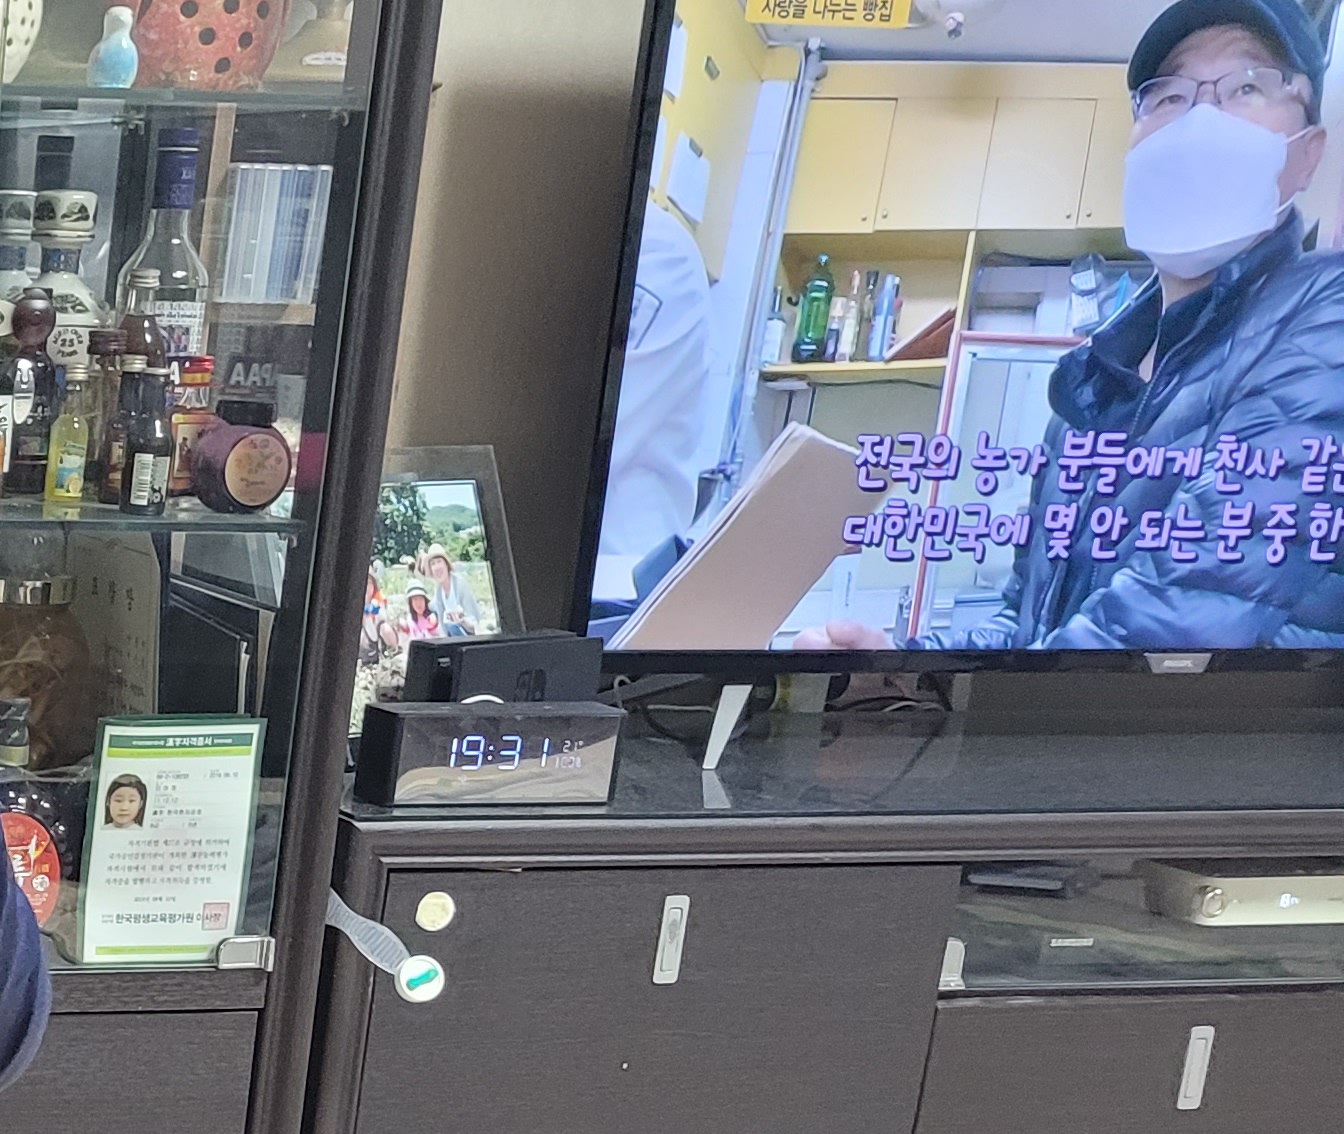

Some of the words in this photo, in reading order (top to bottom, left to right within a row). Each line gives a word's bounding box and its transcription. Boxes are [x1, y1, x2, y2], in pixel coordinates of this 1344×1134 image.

[812, 0, 858, 21] 나누는
[60, 338, 75, 348] 25
[855, 433, 961, 493] 전국의
[970, 430, 1050, 495] 농가
[1056, 429, 1204, 495] 분들에게
[1213, 433, 1286, 493] 천사
[842, 498, 1032, 562] 대한민국에
[1044, 501, 1079, 560] 몇
[1089, 503, 1130, 561] 안
[1134, 502, 1207, 561] 되는
[1216, 499, 1255, 561] 분
[1261, 502, 1299, 566] 중
[448, 734, 551, 771] 19:31
[115, 912, 194, 924] 한국평생교육평가원
